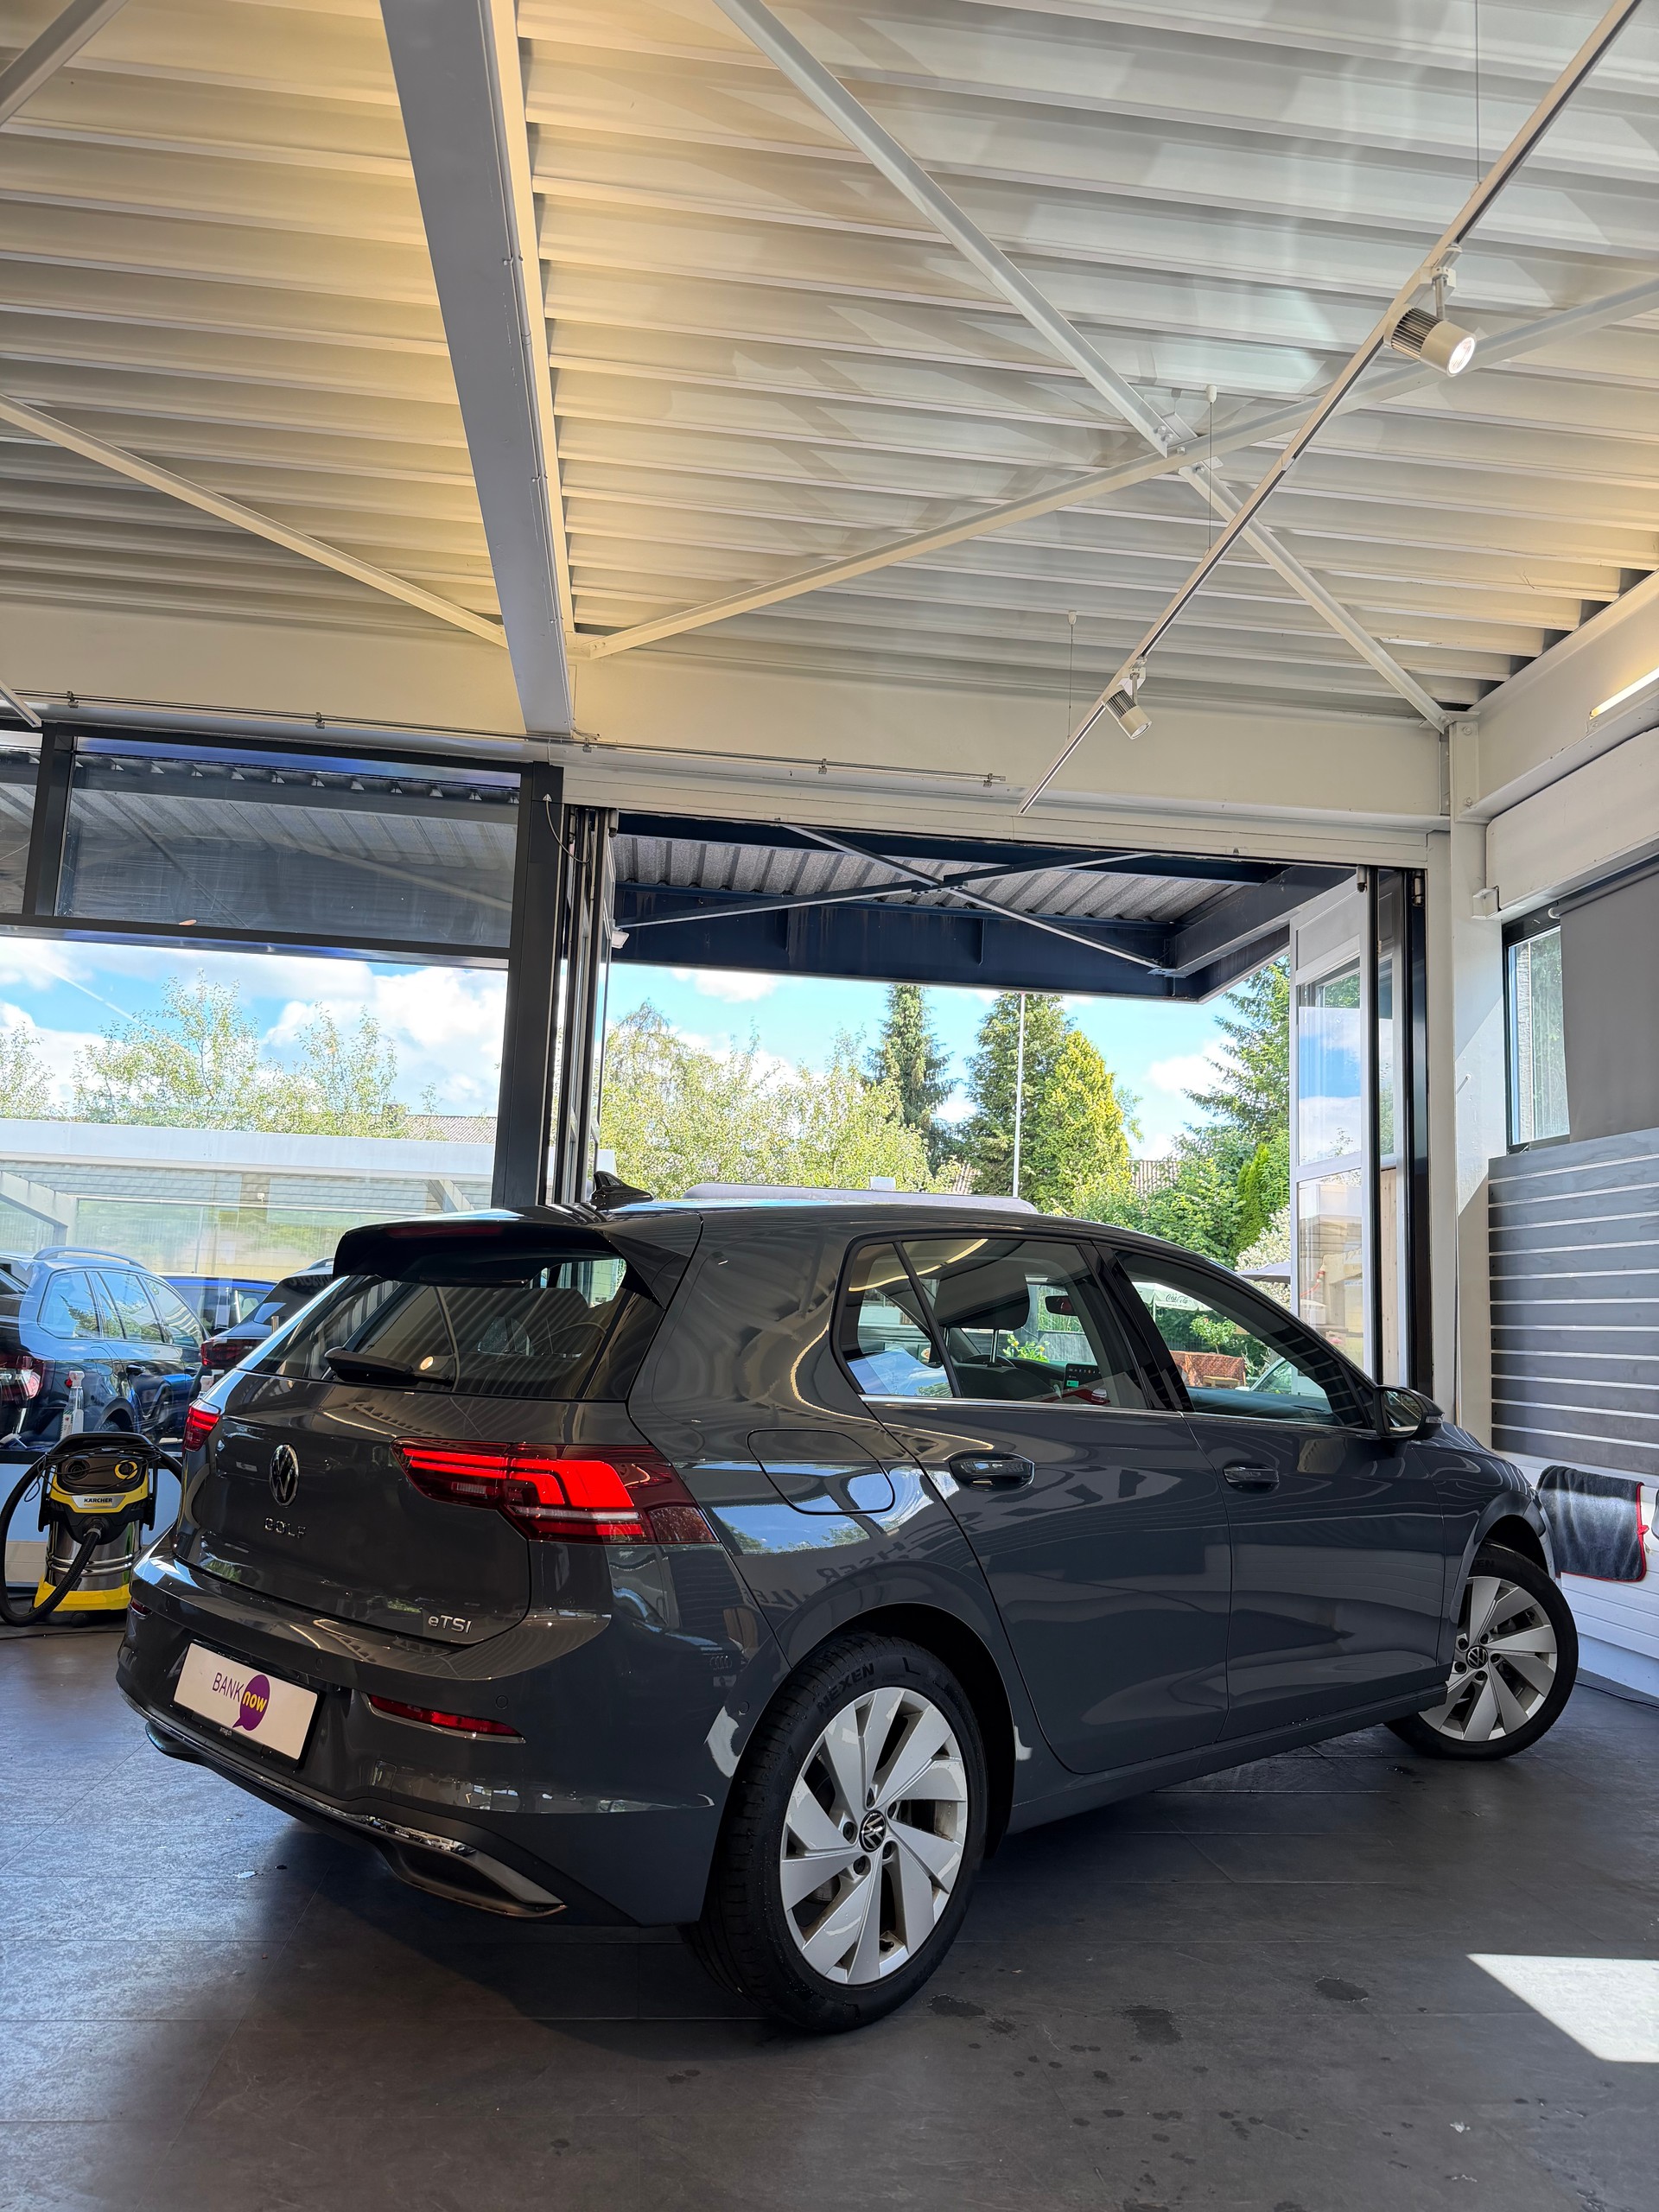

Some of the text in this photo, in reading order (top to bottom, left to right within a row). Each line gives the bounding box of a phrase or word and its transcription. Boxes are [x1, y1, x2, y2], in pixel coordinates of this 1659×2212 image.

[264, 1517, 307, 1539] GOLF
[428, 1614, 472, 1634] eTSI
[212, 1672, 267, 1713] BANK now
[817, 1662, 874, 1713] NEXEN
